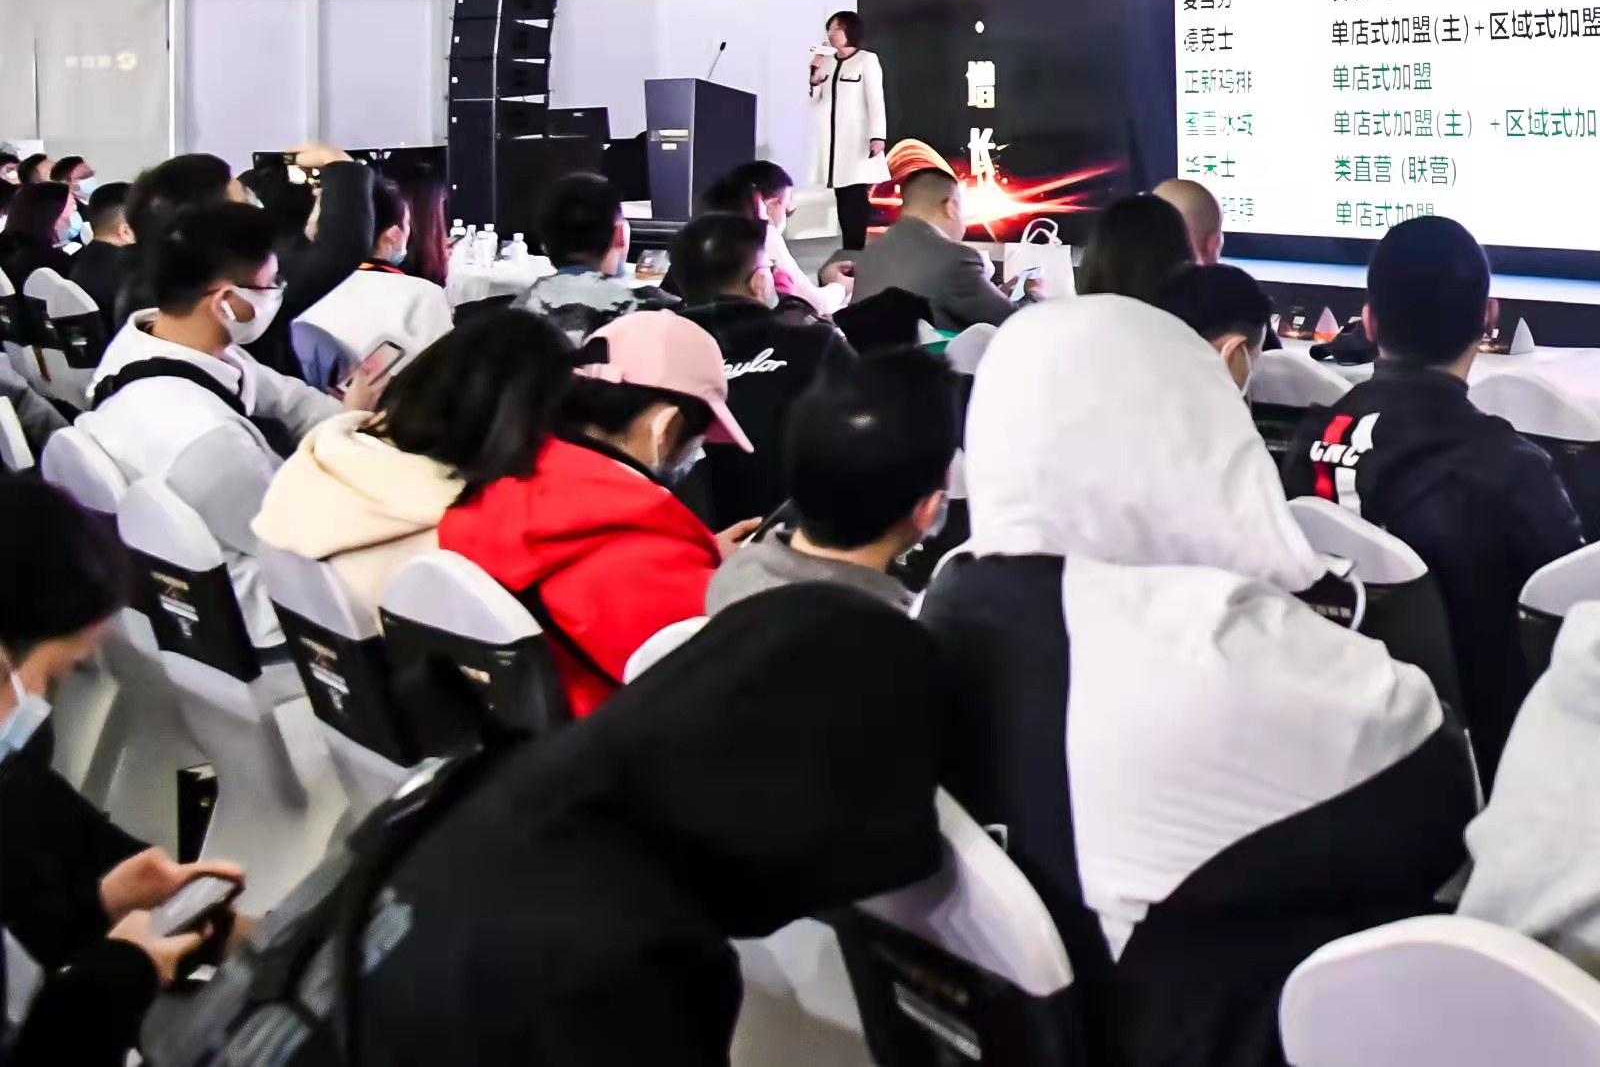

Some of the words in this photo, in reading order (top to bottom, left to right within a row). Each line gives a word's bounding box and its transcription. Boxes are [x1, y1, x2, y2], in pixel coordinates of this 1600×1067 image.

[1183, 25, 1234, 52] 德克士
[1332, 62, 1432, 91] 单店式加盟
